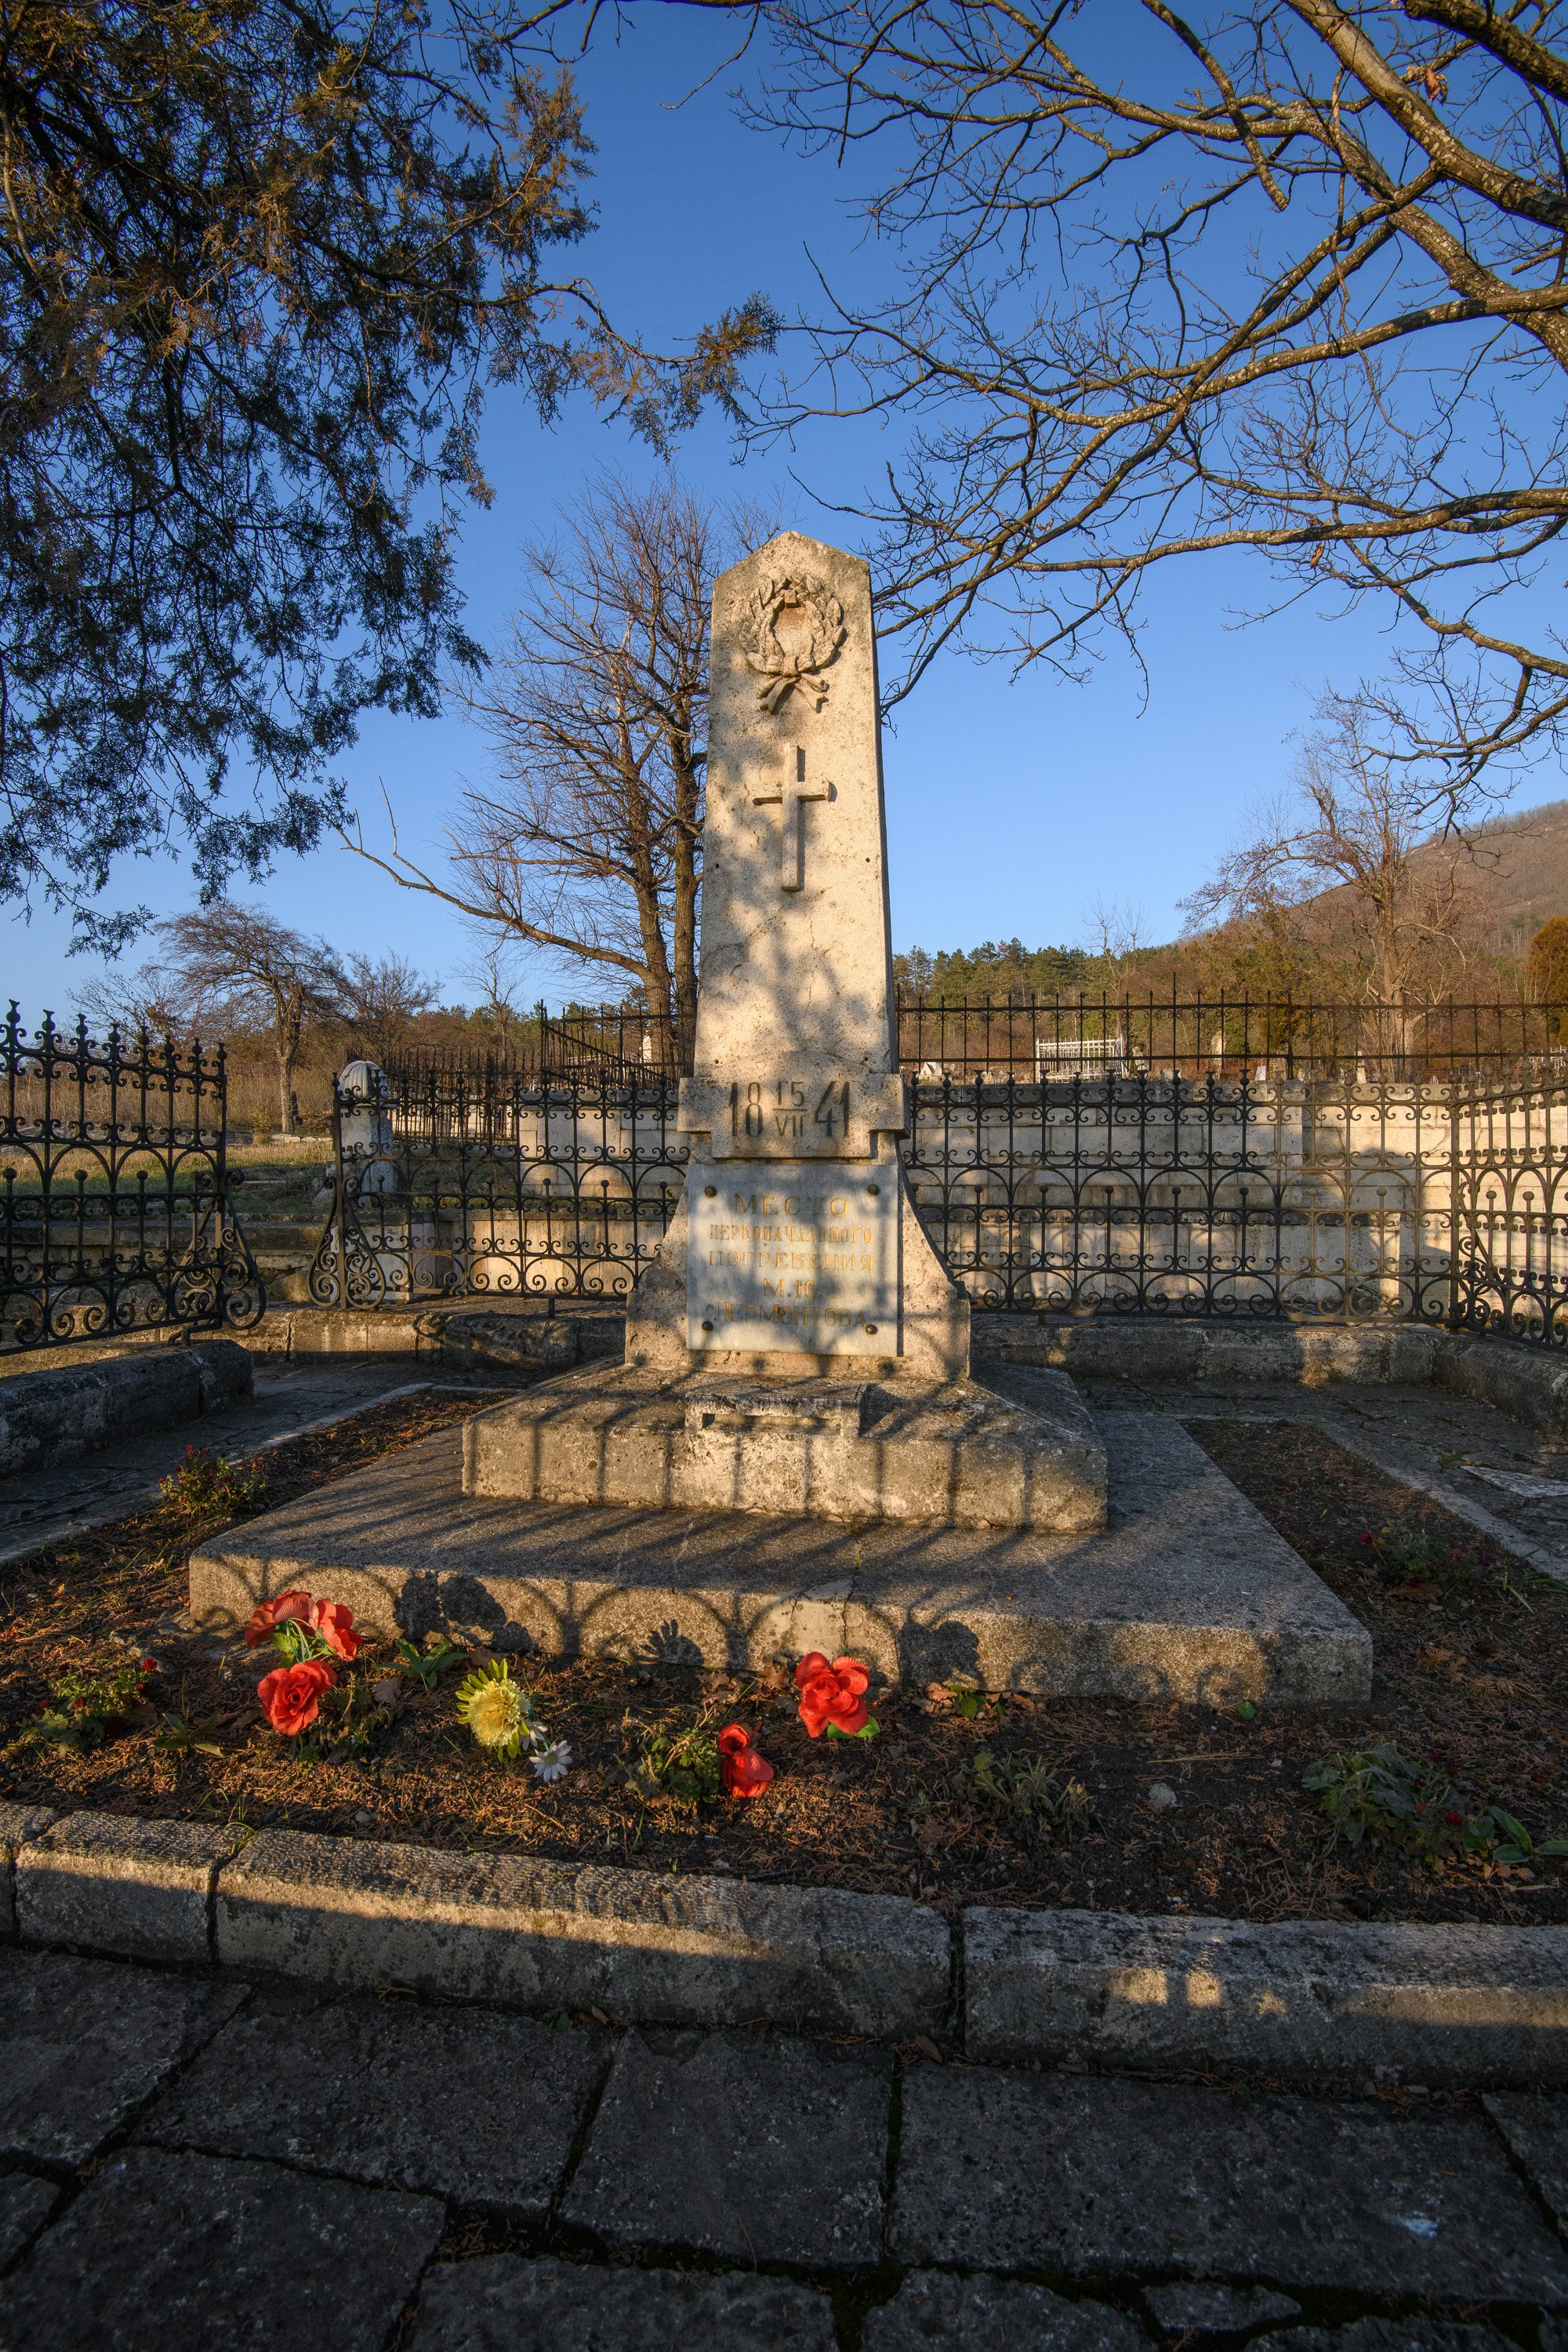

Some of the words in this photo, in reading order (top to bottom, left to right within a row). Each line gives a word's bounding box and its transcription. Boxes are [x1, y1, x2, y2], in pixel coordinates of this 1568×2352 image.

[729, 1082, 763, 1137] 18
[776, 1081, 804, 1106] 15
[815, 1080, 850, 1137] 41
[775, 1115, 804, 1137] VII
[735, 1194, 849, 1217] МЕСТО
[709, 1224, 874, 1243] ПЕРВОНАЧАЛЬНОГО
[709, 1250, 875, 1271] ПОГРЕБЕНИЯ
[713, 1299, 868, 1328] ЛЕРМОНТОВА
